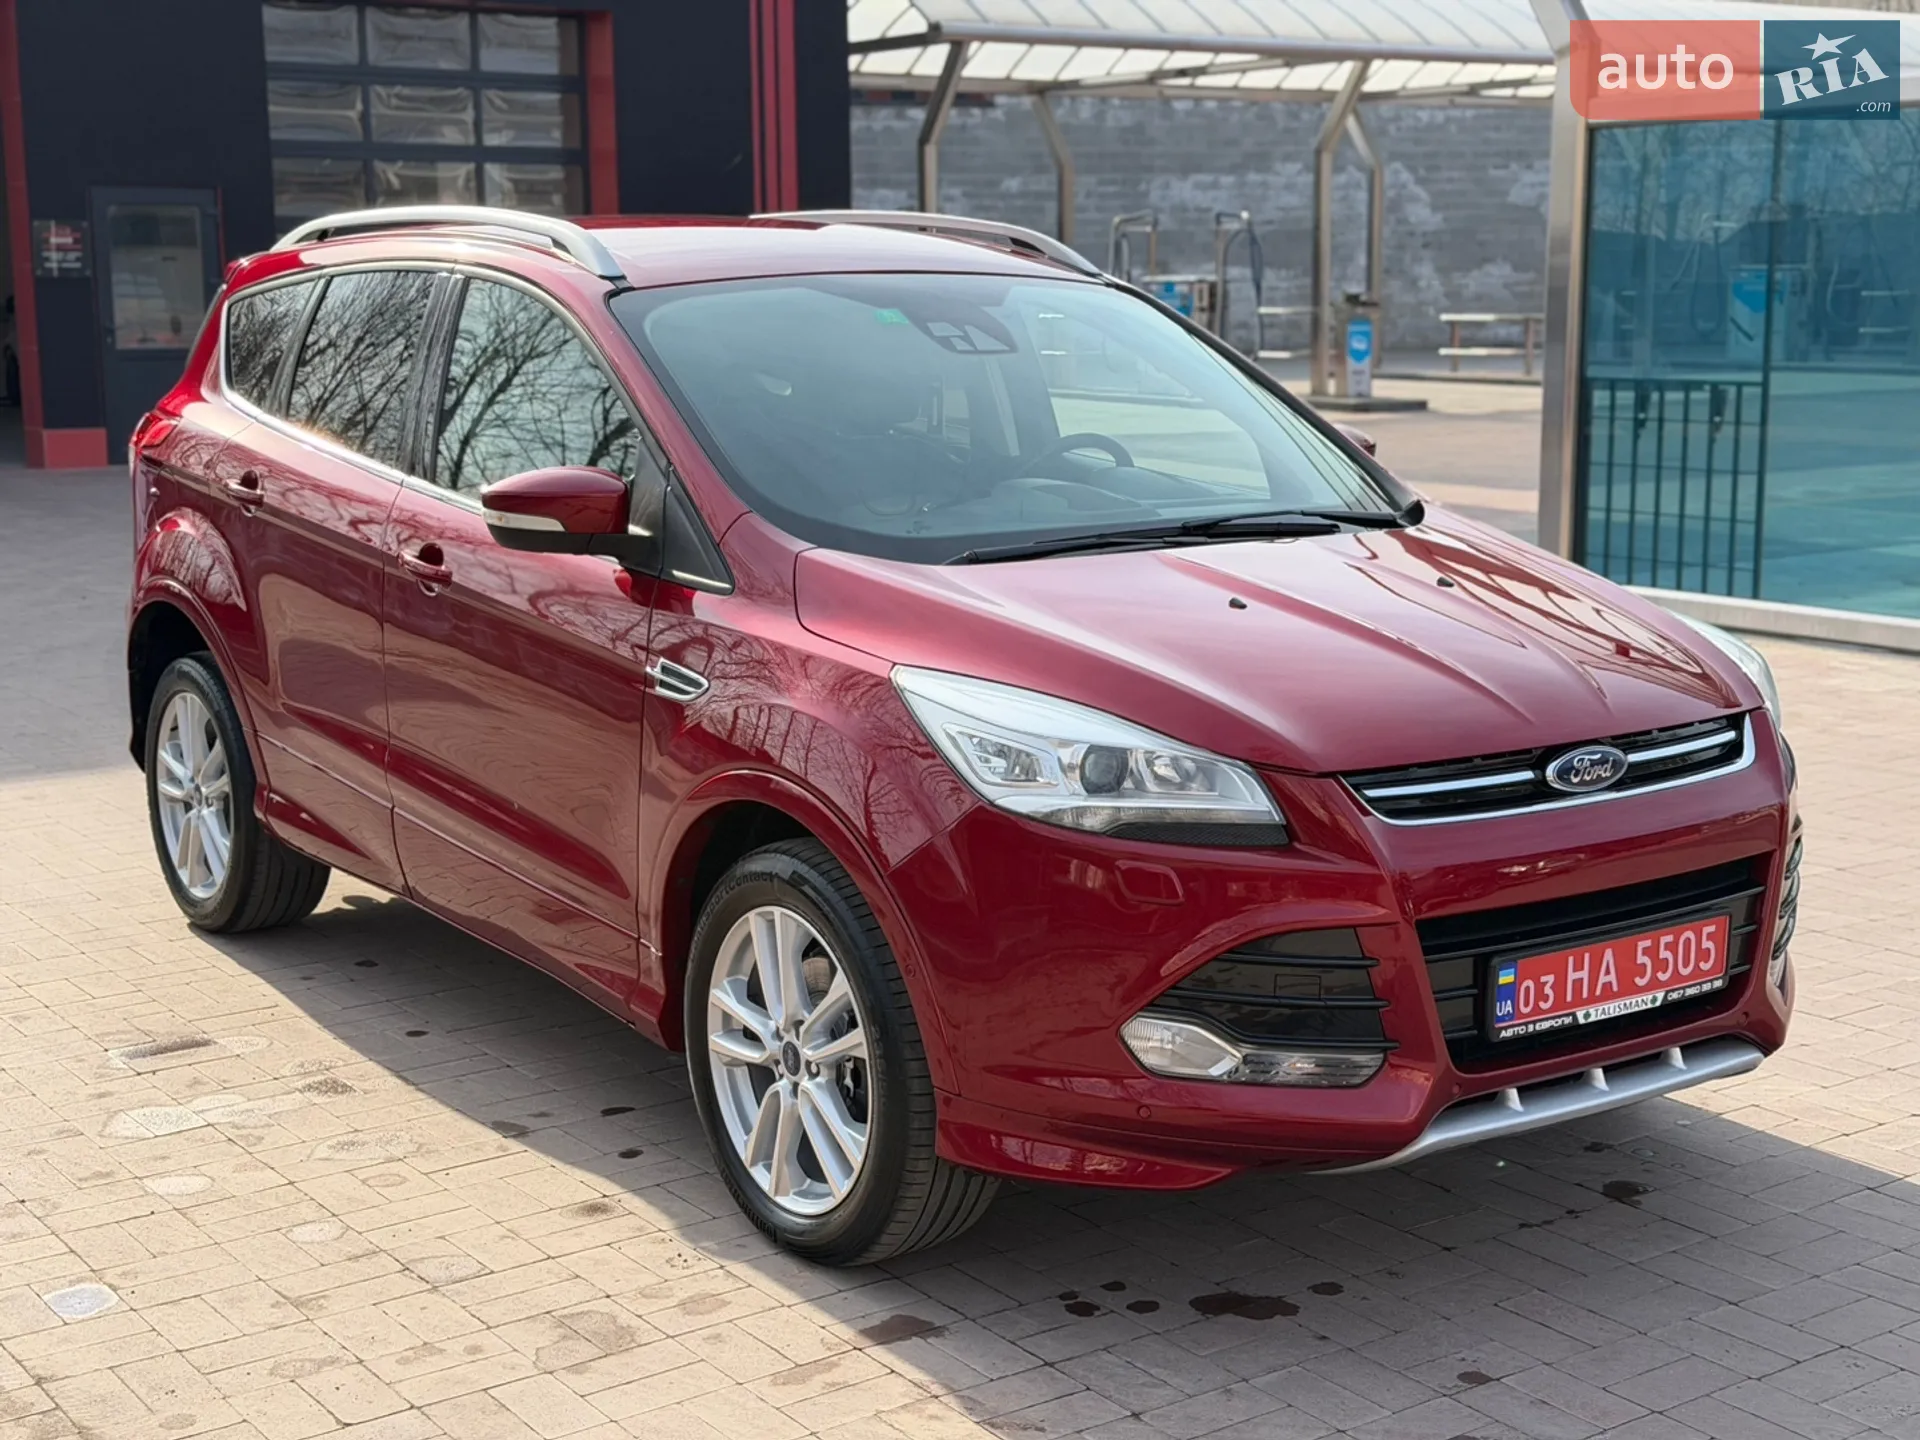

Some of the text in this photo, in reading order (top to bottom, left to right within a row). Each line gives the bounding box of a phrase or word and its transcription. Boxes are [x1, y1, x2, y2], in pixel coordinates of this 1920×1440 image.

[1570, 753, 1614, 783] Ford
[1519, 924, 1717, 1015] 03 HA 5505
[1496, 999, 1513, 1017] UA
[1594, 997, 1650, 1019] TALISMAN
